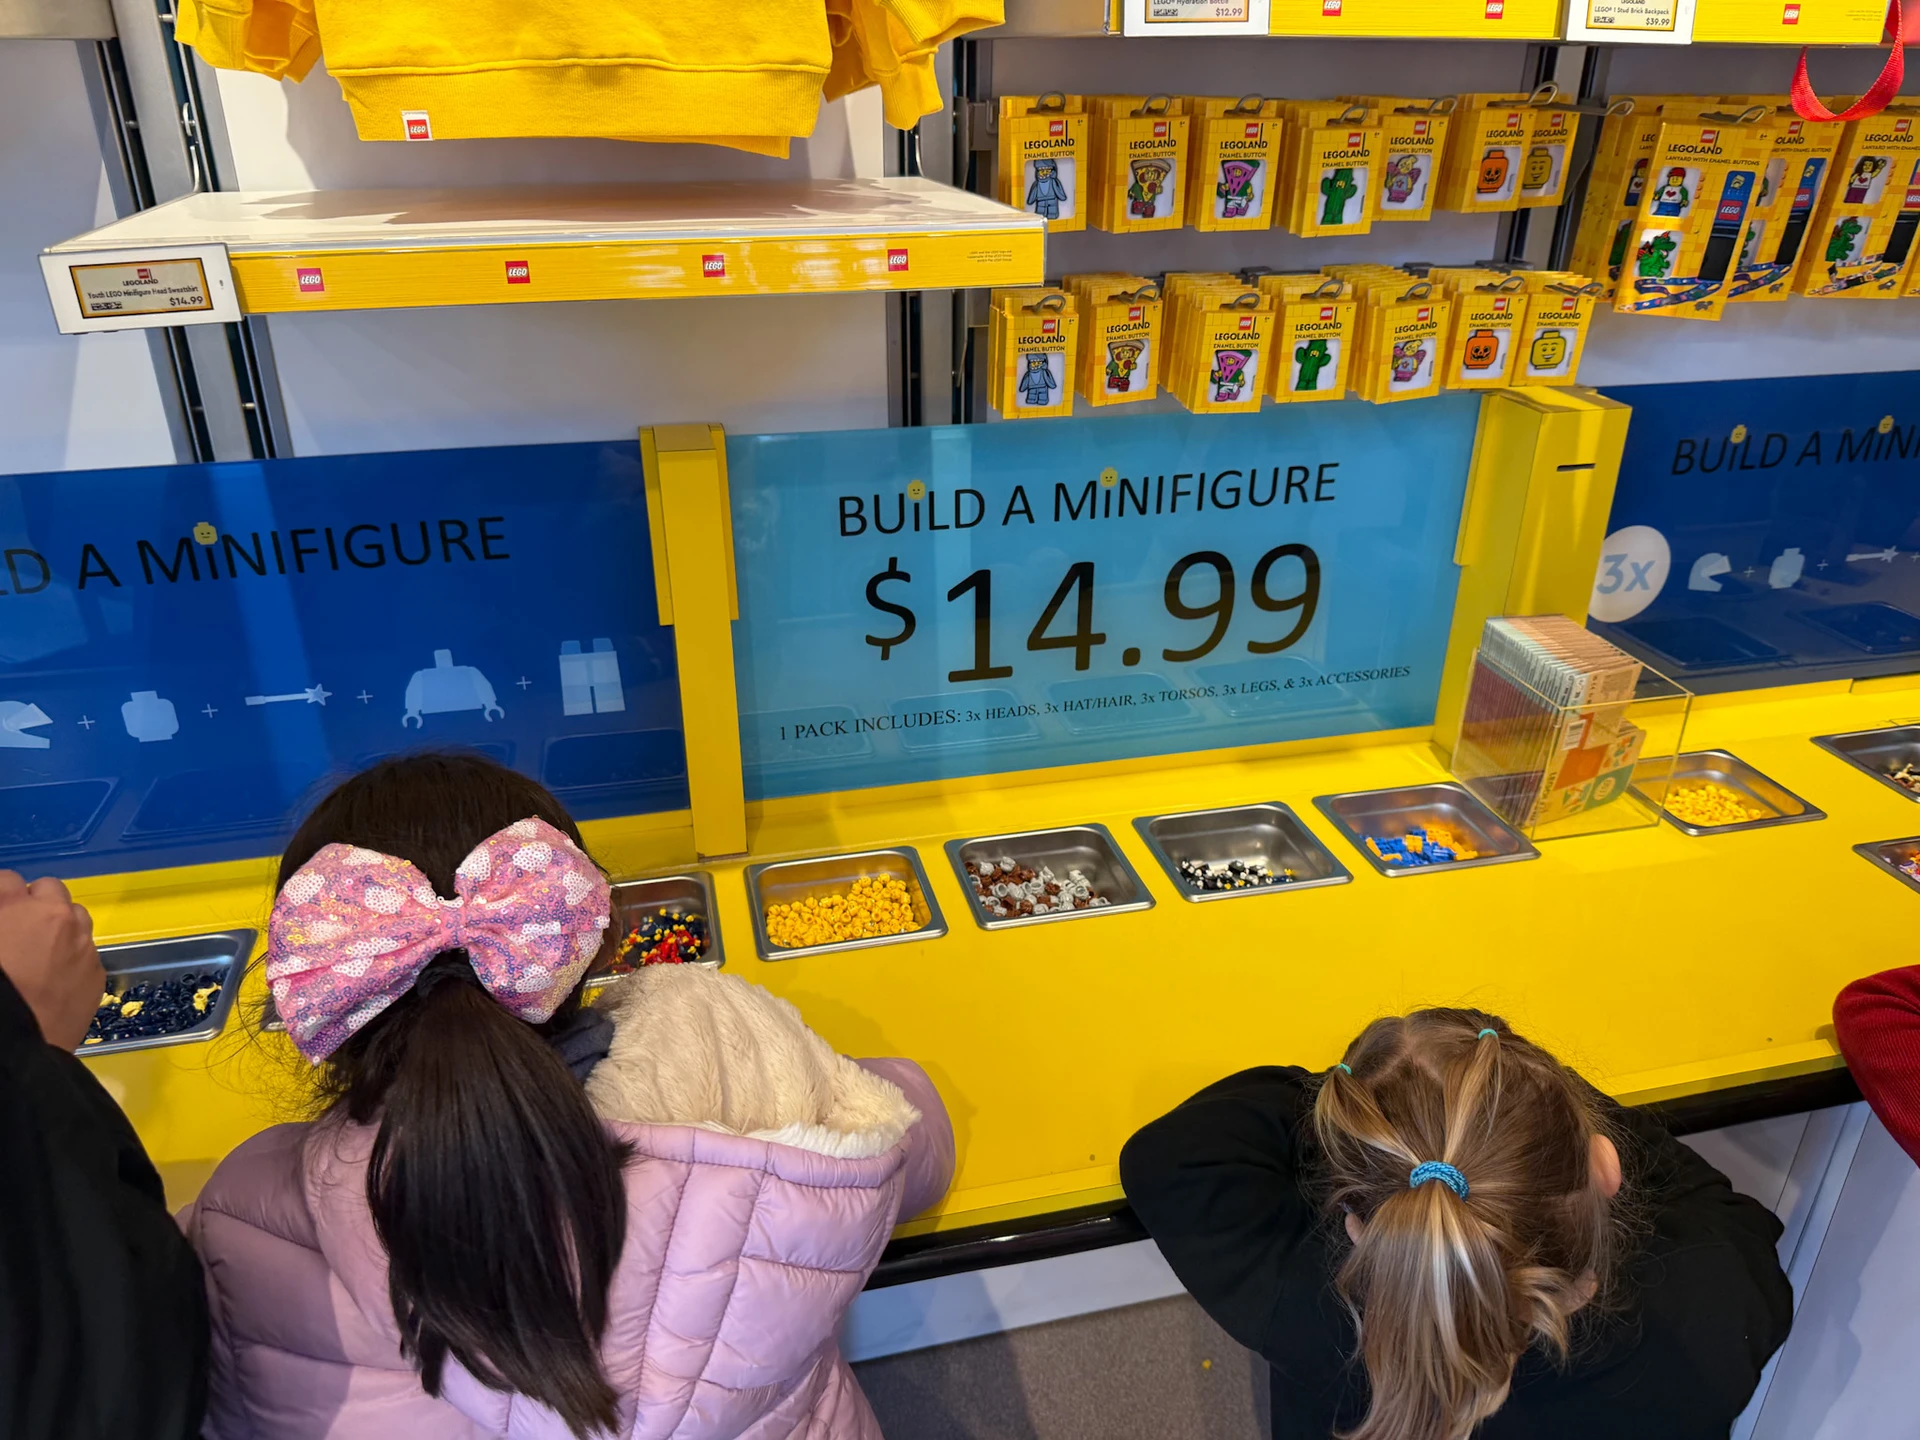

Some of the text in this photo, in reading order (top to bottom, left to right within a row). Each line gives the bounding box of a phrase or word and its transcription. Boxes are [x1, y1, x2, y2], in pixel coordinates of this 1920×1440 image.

[1325, 0, 1340, 9] LEGO
[1487, 3, 1502, 12] LEGO
[1215, 8, 1243, 16] $12.99
[1646, 18, 1670, 26] $39.99
[1390, 137, 1434, 145] LEGOLAND
[1775, 136, 1805, 145] OLAND
[1864, 133, 1914, 143] LEGOLAND
[1024, 138, 1075, 149] LEGOLAND
[1130, 139, 1176, 150] LEGOLAND
[1220, 140, 1268, 150] LEGOLAND
[1323, 149, 1370, 159] LEGOLAND
[1668, 144, 1723, 155] LEGOLAND
[1665, 155, 1692, 163] LANYARD
[1720, 205, 1740, 214] LEGO
[890, 255, 907, 264] LEGO
[705, 261, 723, 270] LEGO
[508, 268, 527, 277] LEGO
[122, 279, 159, 287] LEGOLAND
[301, 275, 321, 285] LEGO
[87, 285, 199, 299] Youth LEGO Minifigure Head Sweatshirt
[169, 296, 204, 306] $14.99
[1471, 312, 1513, 320] LEGOLAND
[1538, 312, 1581, 320] LEGOLAND
[1106, 321, 1150, 333] LEGOLAND
[1295, 322, 1342, 331] LEGOLAND
[1394, 321, 1438, 334] LEGOLAND
[1018, 335, 1066, 345] LEGOLAND
[1214, 332, 1260, 340] LEGOLAND
[1795, 431, 1822, 467] A
[1002, 485, 1035, 527] A
[77, 544, 122, 590] A
[1595, 553, 1656, 594] 3x
[865, 543, 1321, 684] $14.99
[779, 666, 1411, 740] 1 PACK INCLUDES: 3x HEADS, 3x HAT/HAIR, 3x TORSOS, 3x LEGS, & 3x ACCESSORIES
